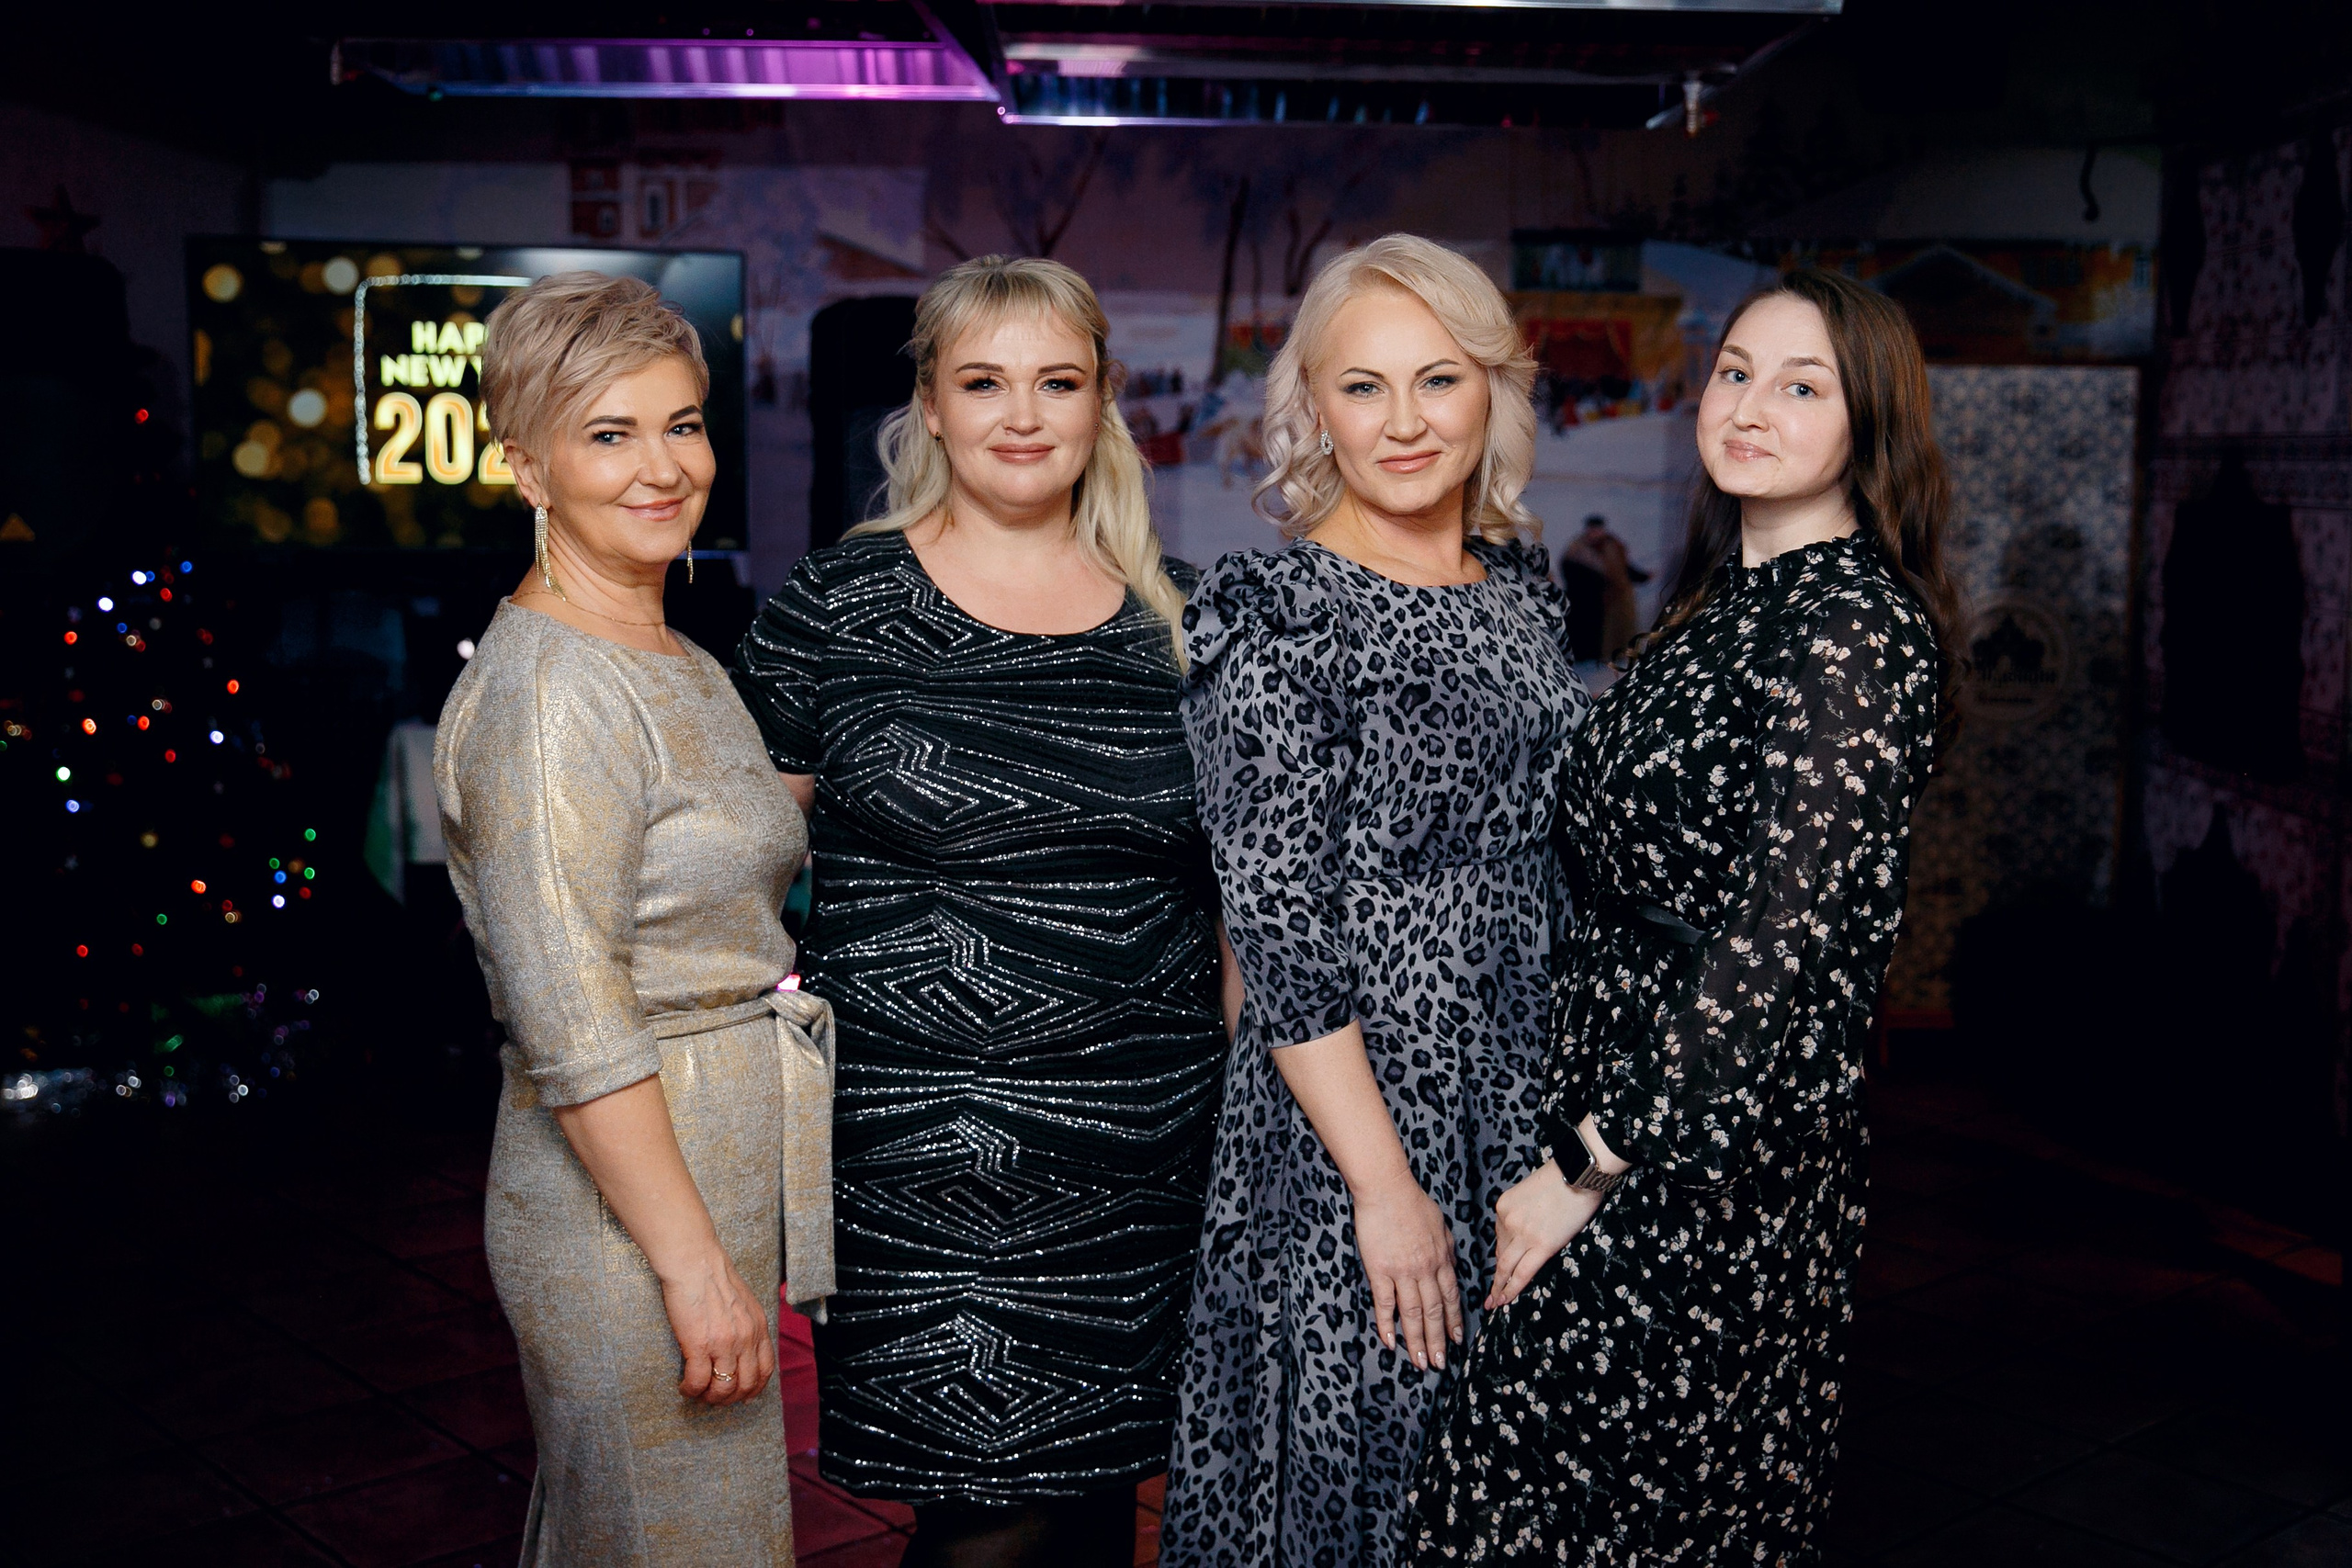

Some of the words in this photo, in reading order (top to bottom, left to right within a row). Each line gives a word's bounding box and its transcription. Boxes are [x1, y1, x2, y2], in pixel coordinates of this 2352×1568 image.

[412, 321, 490, 355] HAP
[380, 354, 467, 387] NEW
[374, 391, 517, 485] 202
